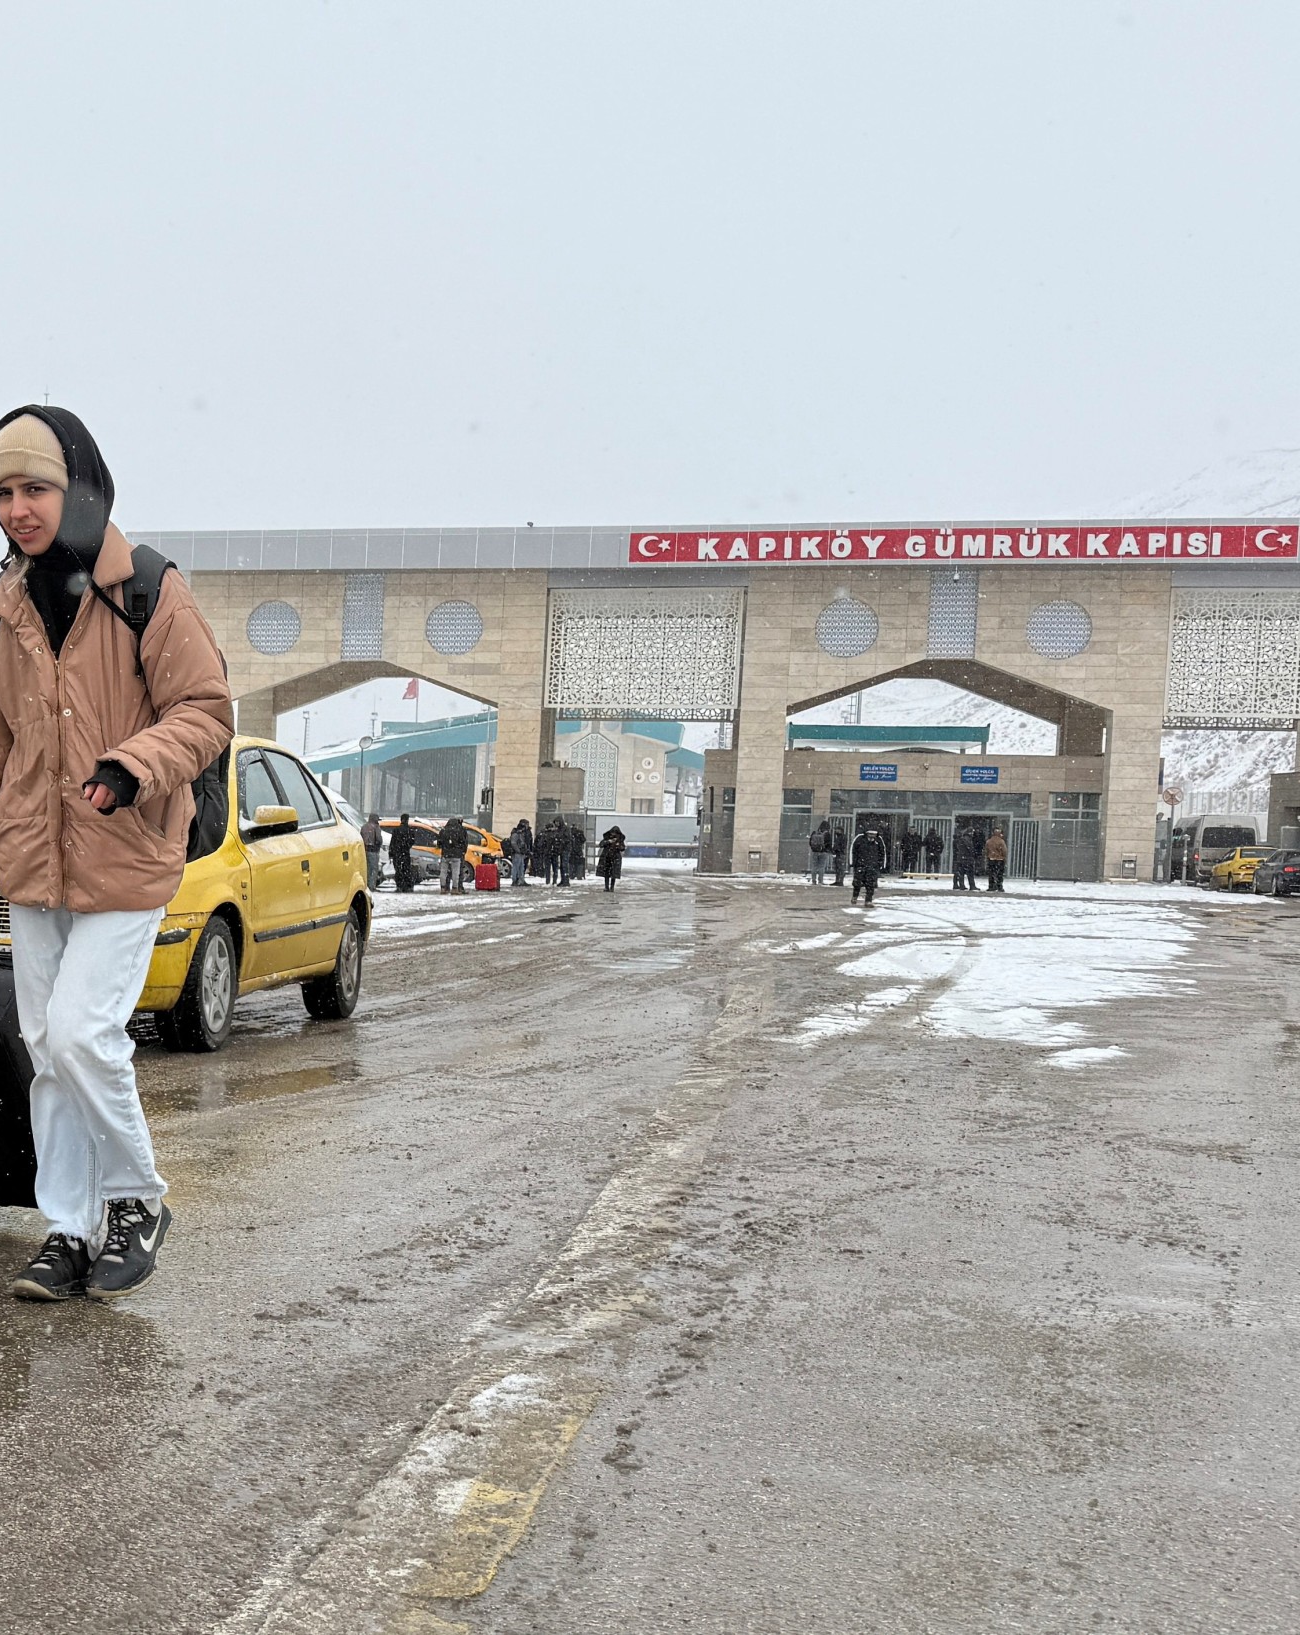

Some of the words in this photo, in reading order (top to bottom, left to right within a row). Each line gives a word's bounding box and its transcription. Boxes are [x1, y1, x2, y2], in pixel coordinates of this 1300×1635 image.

[697, 529, 886, 560] KAPIKÖY
[904, 527, 1072, 558] GÜMRÜK
[1086, 532, 1222, 556] KAPISI
